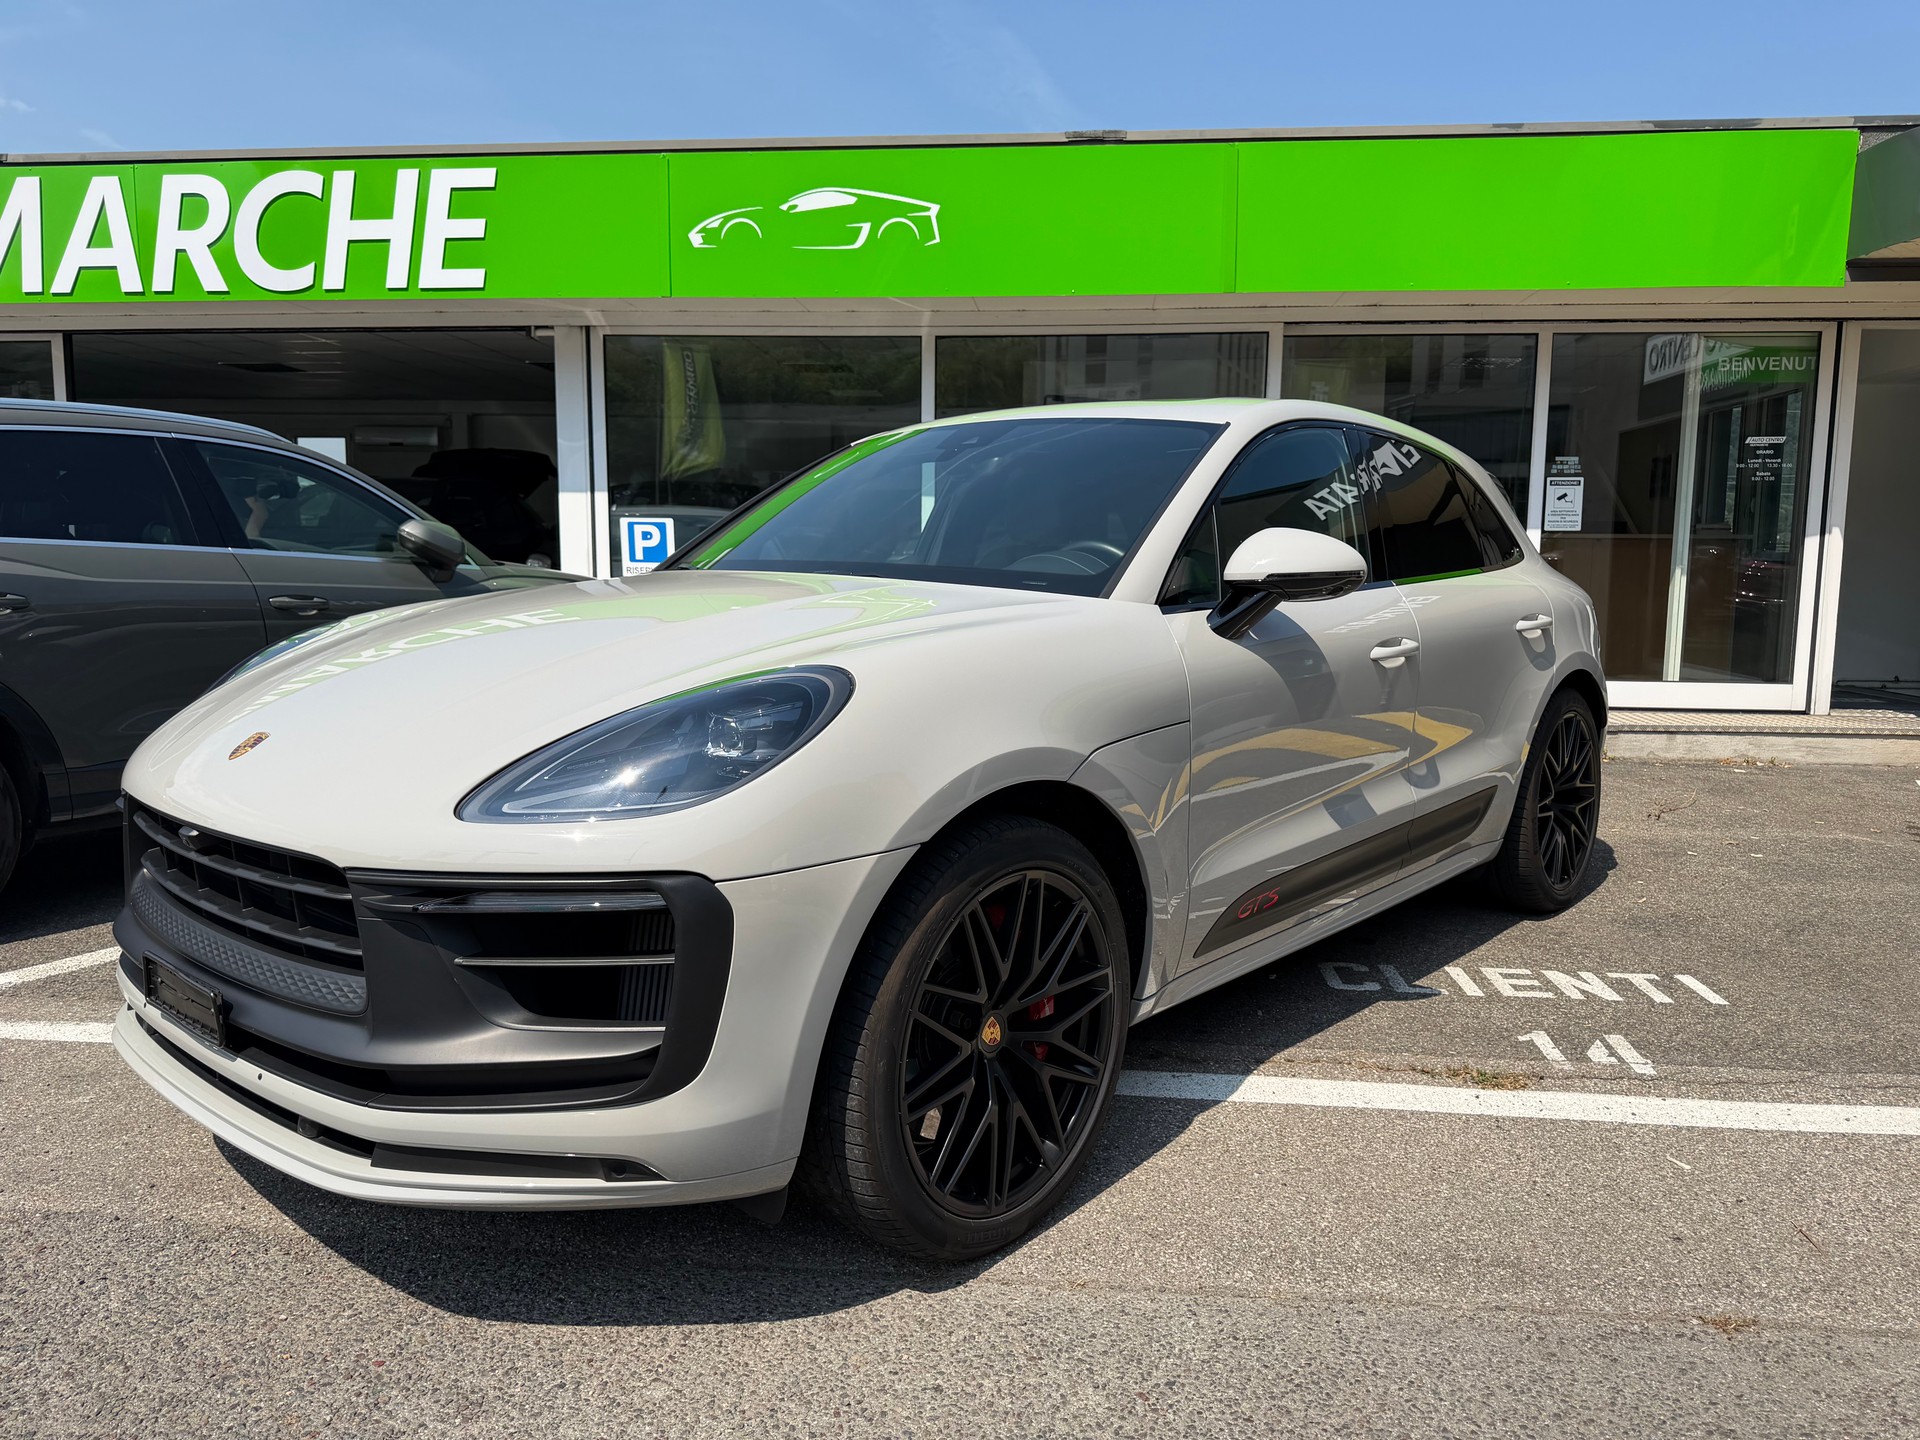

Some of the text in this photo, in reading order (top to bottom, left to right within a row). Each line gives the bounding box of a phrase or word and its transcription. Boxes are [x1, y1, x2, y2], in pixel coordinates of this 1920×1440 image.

[633, 524, 661, 560] P
[1237, 887, 1281, 918] GTS
[1319, 961, 1730, 1005] CLIENTI
[1517, 1030, 1658, 1076] 14
